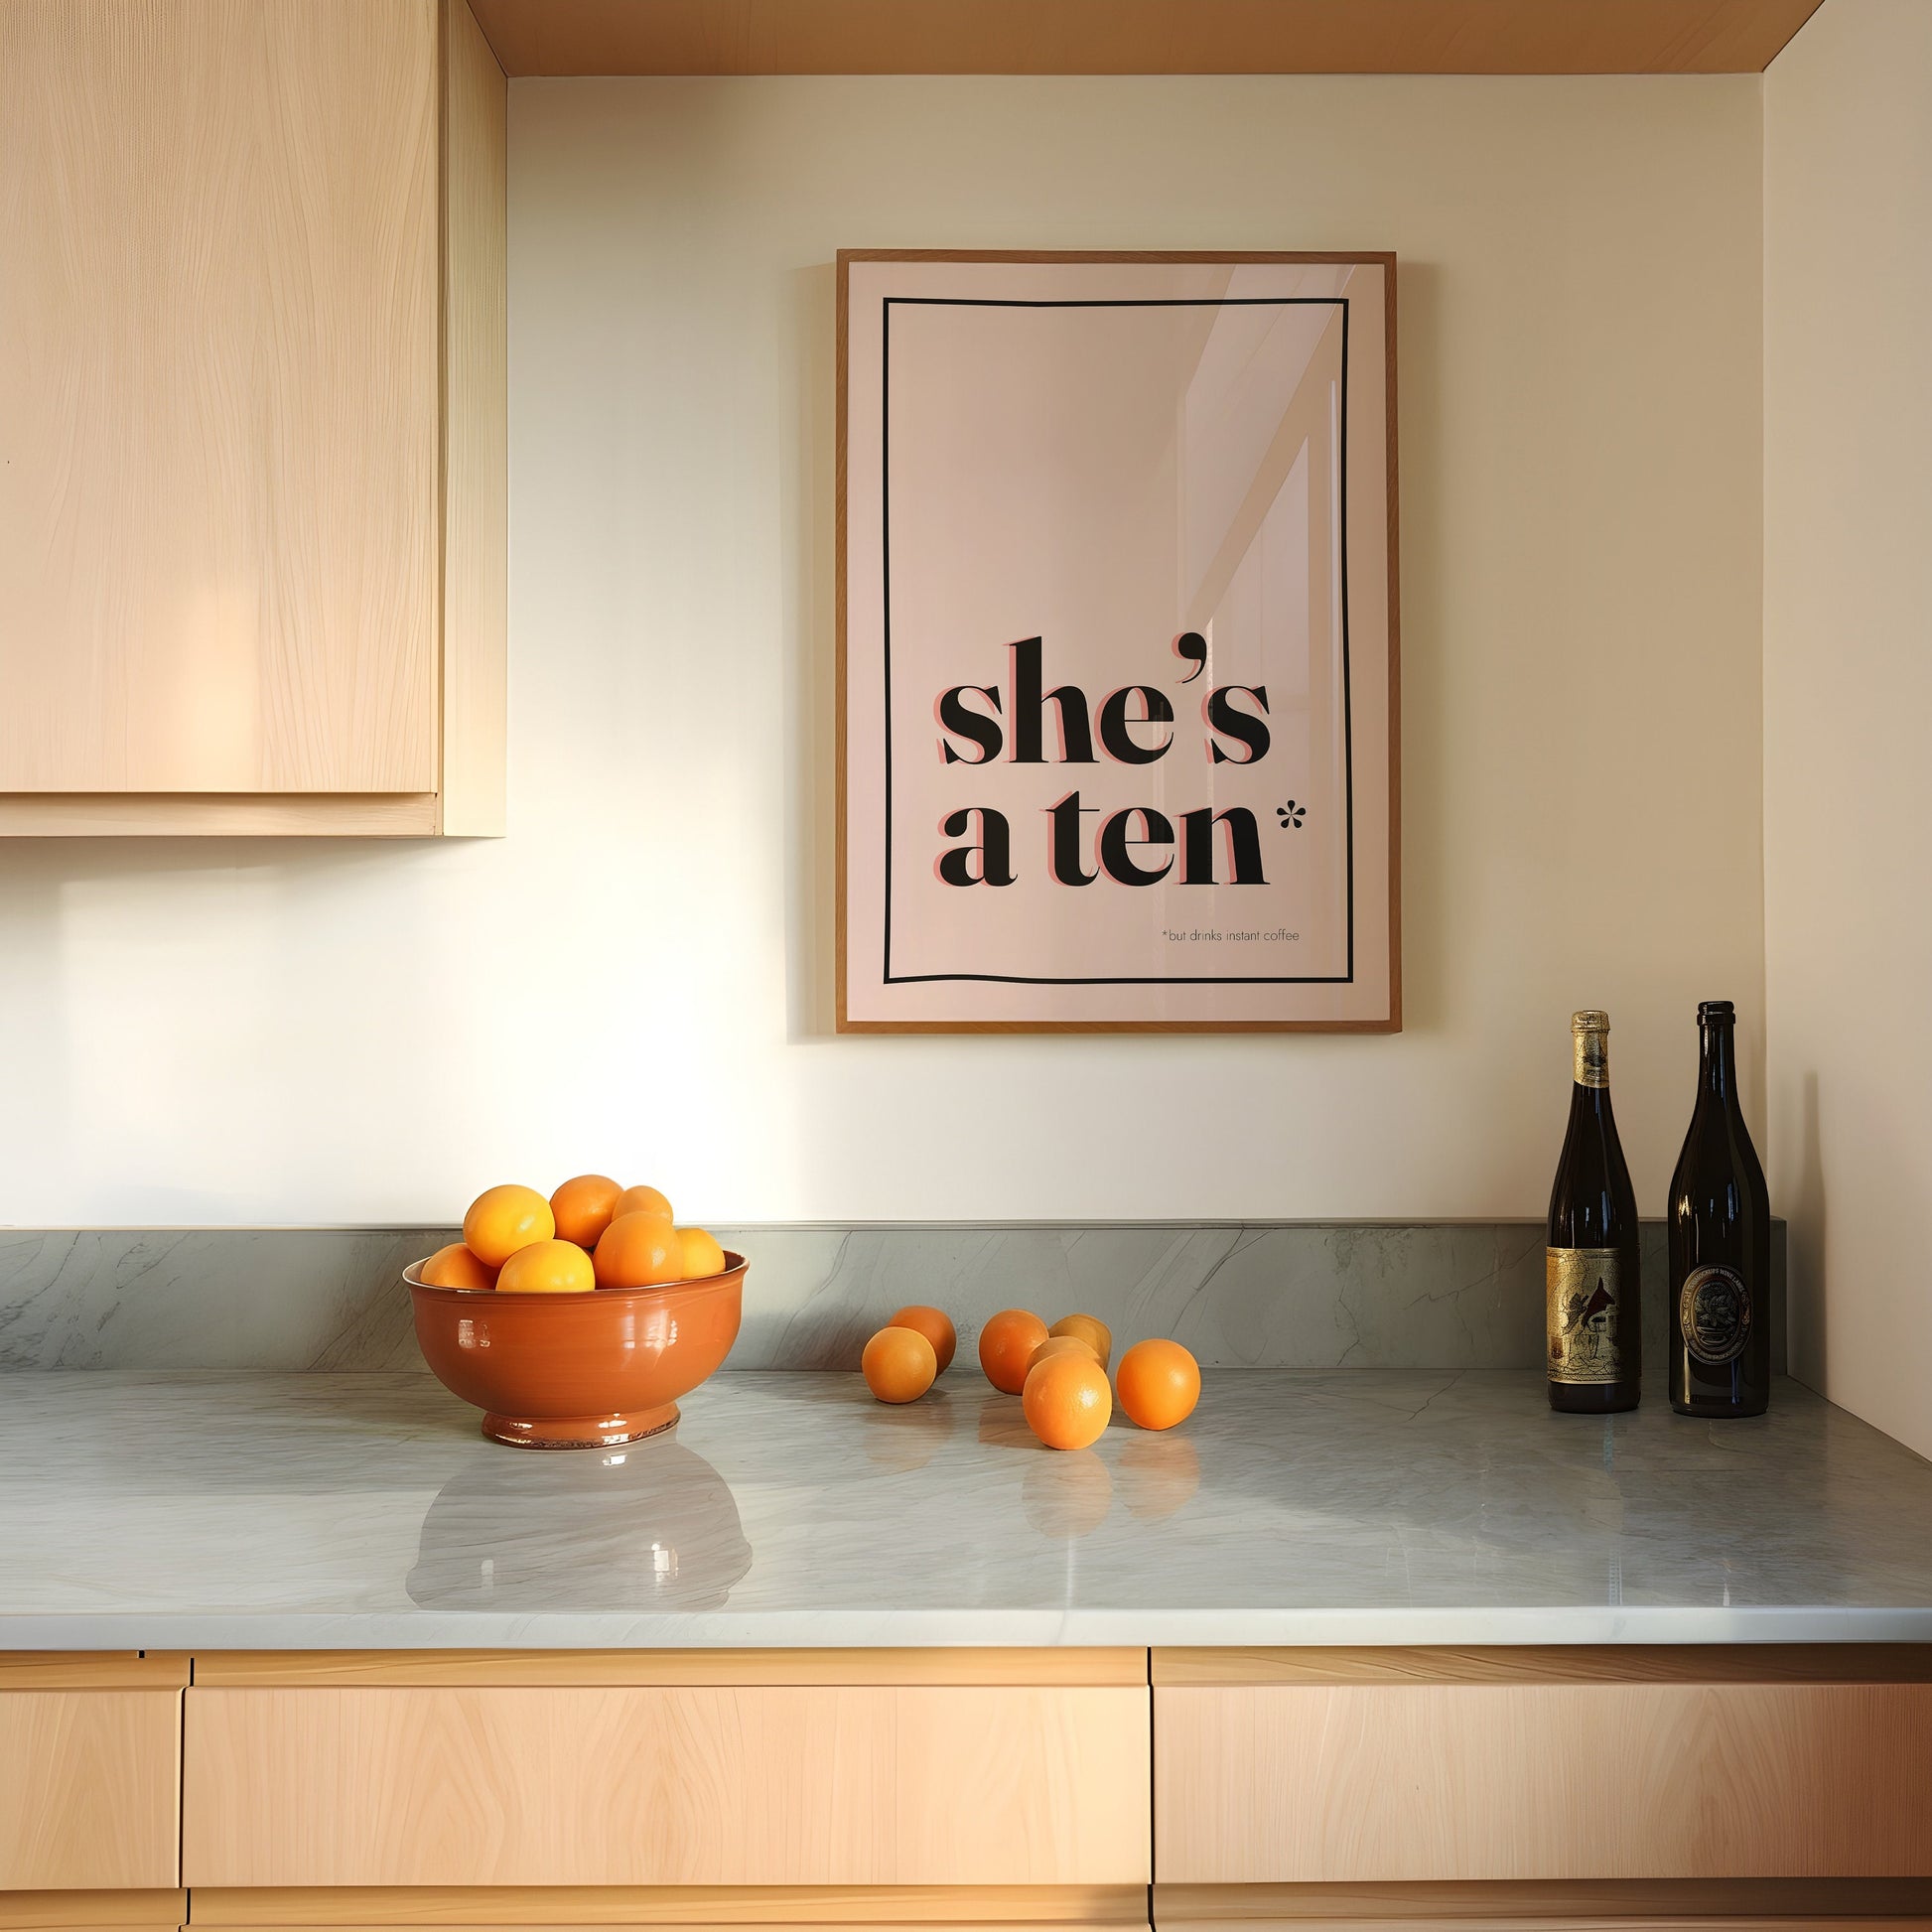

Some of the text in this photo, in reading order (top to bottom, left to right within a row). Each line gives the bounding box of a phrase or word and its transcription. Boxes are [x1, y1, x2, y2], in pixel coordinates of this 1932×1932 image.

[933, 631, 1271, 764] she’s
[933, 807, 1019, 888] a
[1189, 929, 1222, 941] drinks
[1226, 930, 1260, 941] instant
[1263, 928, 1300, 941] coffee
